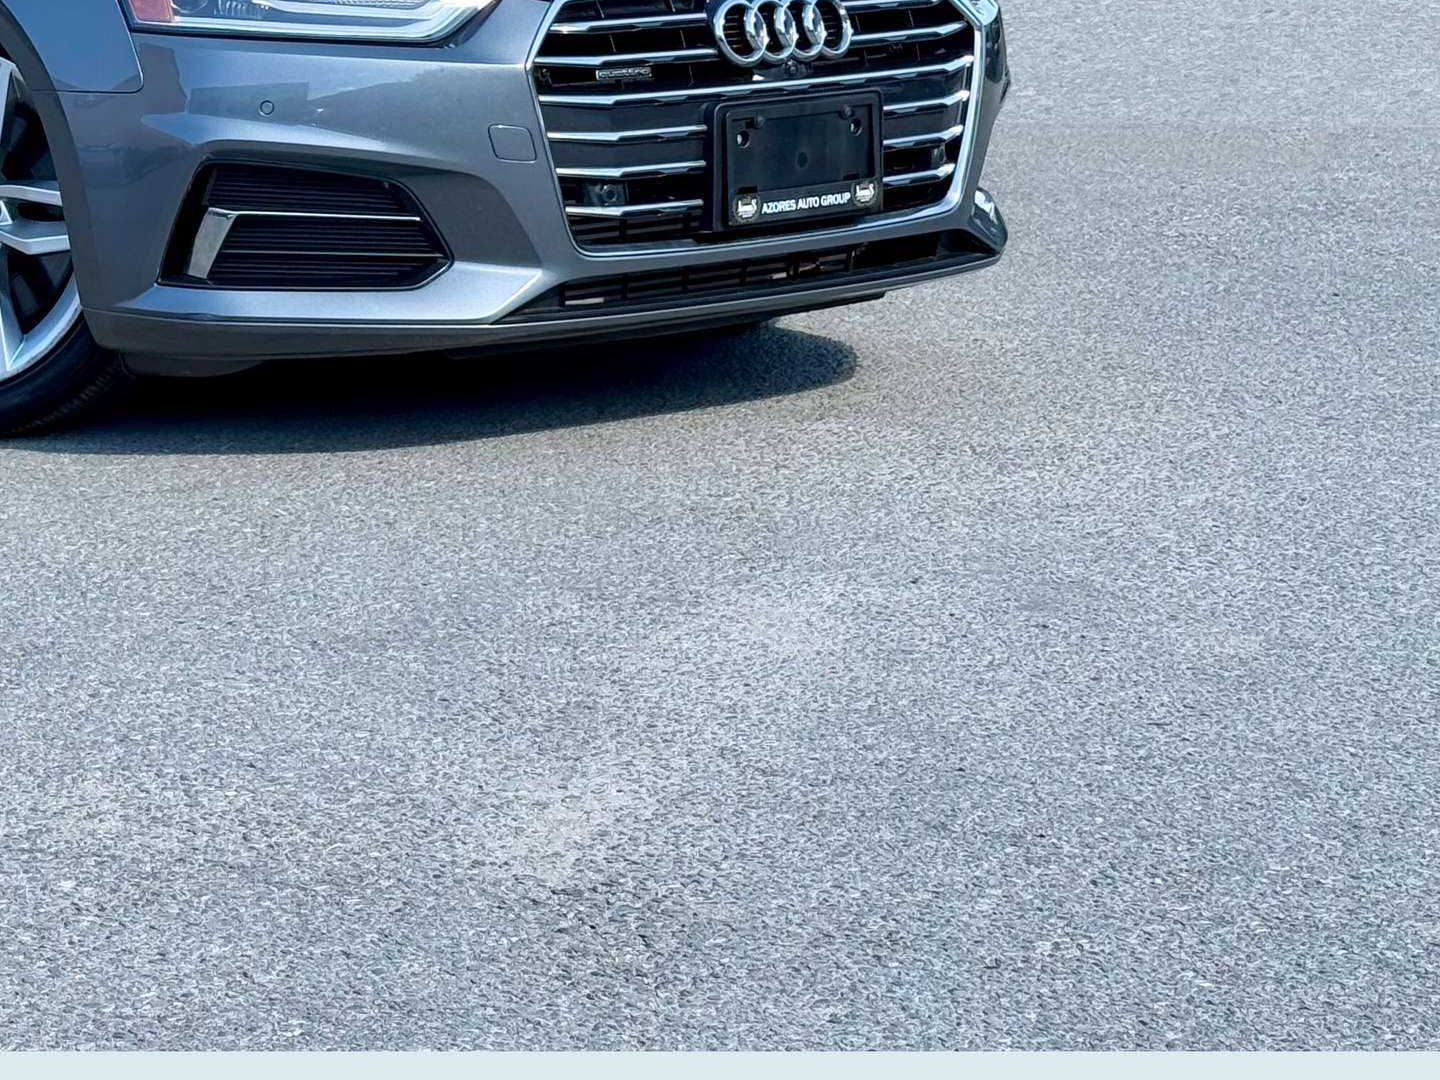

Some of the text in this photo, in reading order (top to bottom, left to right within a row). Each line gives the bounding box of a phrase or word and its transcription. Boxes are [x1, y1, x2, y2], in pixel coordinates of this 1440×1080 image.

[762, 199, 796, 214] AZORES
[797, 196, 820, 210] AUTO
[821, 192, 851, 206] GROUP
